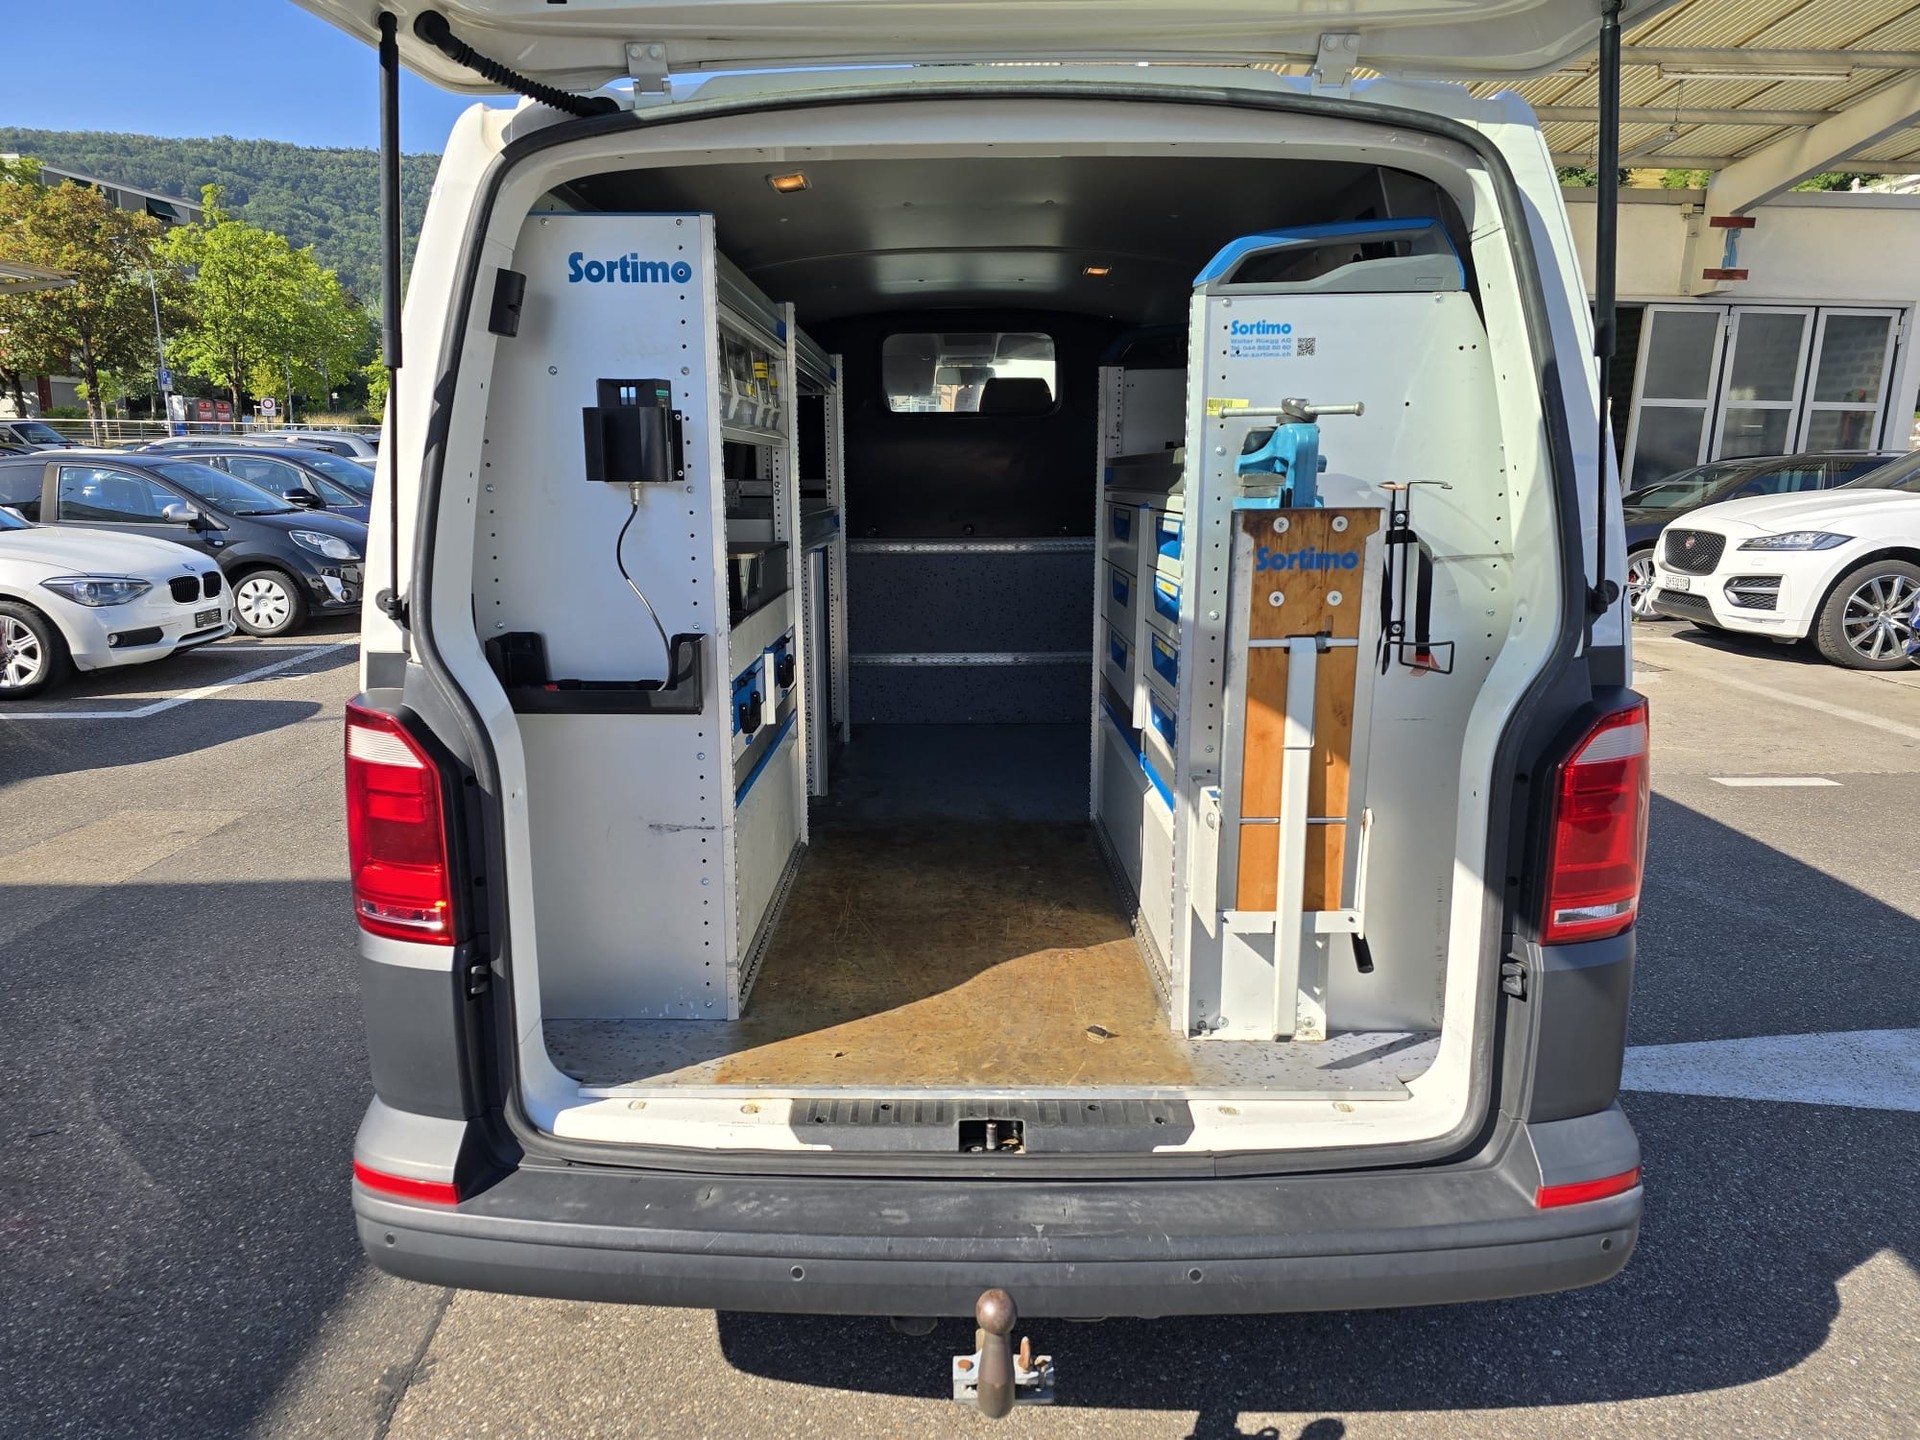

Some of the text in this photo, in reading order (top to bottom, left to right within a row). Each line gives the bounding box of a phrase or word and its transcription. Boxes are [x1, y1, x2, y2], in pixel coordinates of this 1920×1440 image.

[568, 252, 692, 283] Sortimo
[1231, 320, 1292, 335] Sortimo
[1256, 547, 1359, 571] Sortimo
